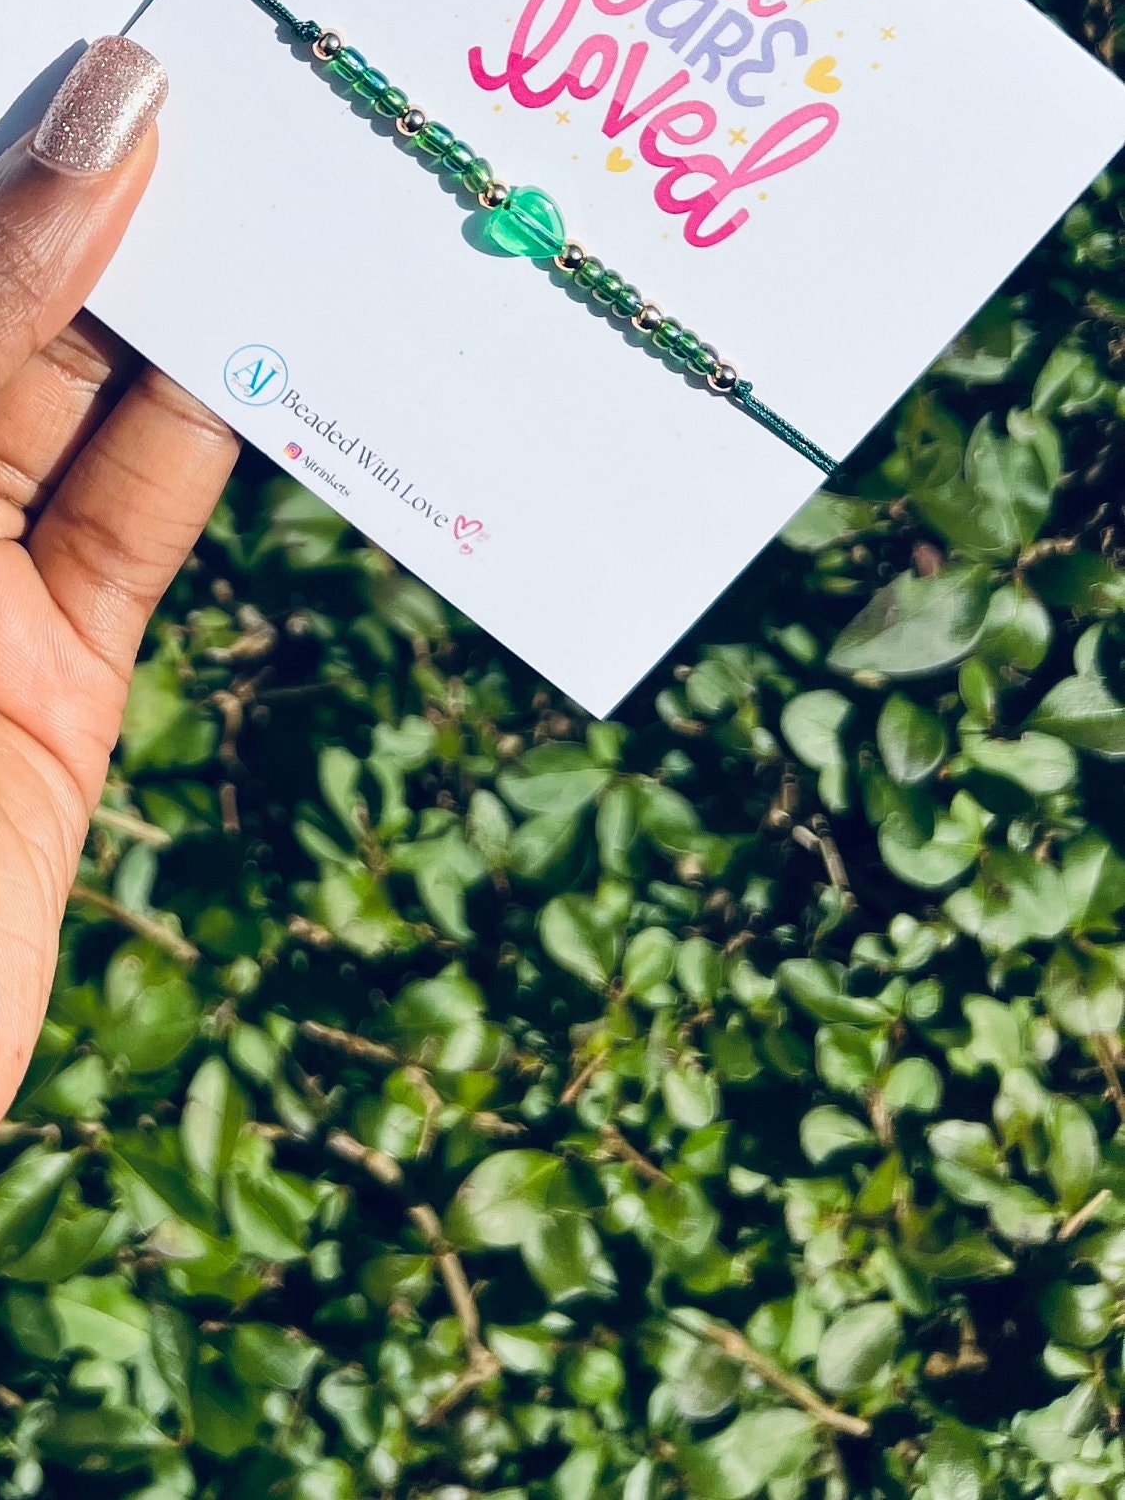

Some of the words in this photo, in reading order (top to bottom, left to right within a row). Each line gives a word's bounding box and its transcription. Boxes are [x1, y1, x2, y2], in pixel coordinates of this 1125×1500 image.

[280, 389, 360, 456] Beaded
[357, 446, 401, 493] With
[399, 483, 449, 529] Love
